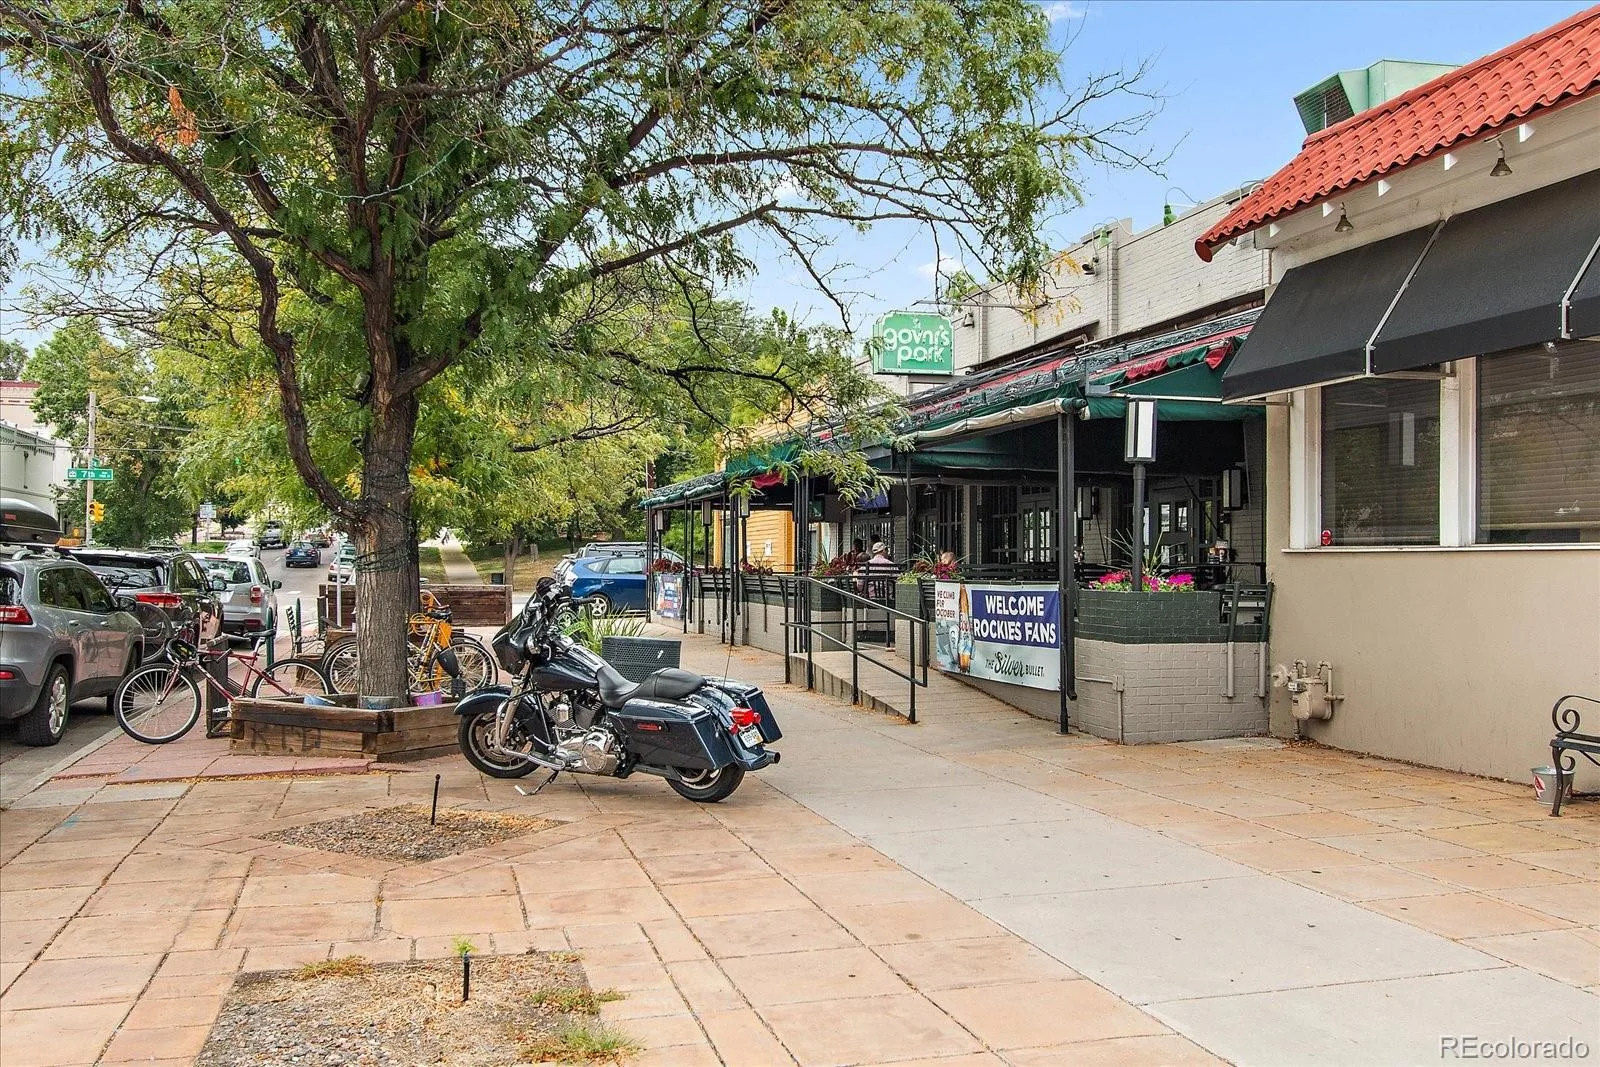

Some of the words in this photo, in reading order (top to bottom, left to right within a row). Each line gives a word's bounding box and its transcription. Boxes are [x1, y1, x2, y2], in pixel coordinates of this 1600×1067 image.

[897, 344, 945, 368] park
[81, 470, 96, 478] 7th
[985, 594, 1045, 616] WELCOME
[973, 618, 1021, 641] ROCKIES
[1024, 621, 1056, 644] FANS
[985, 659, 995, 670] THE
[994, 651, 1024, 677] Silver
